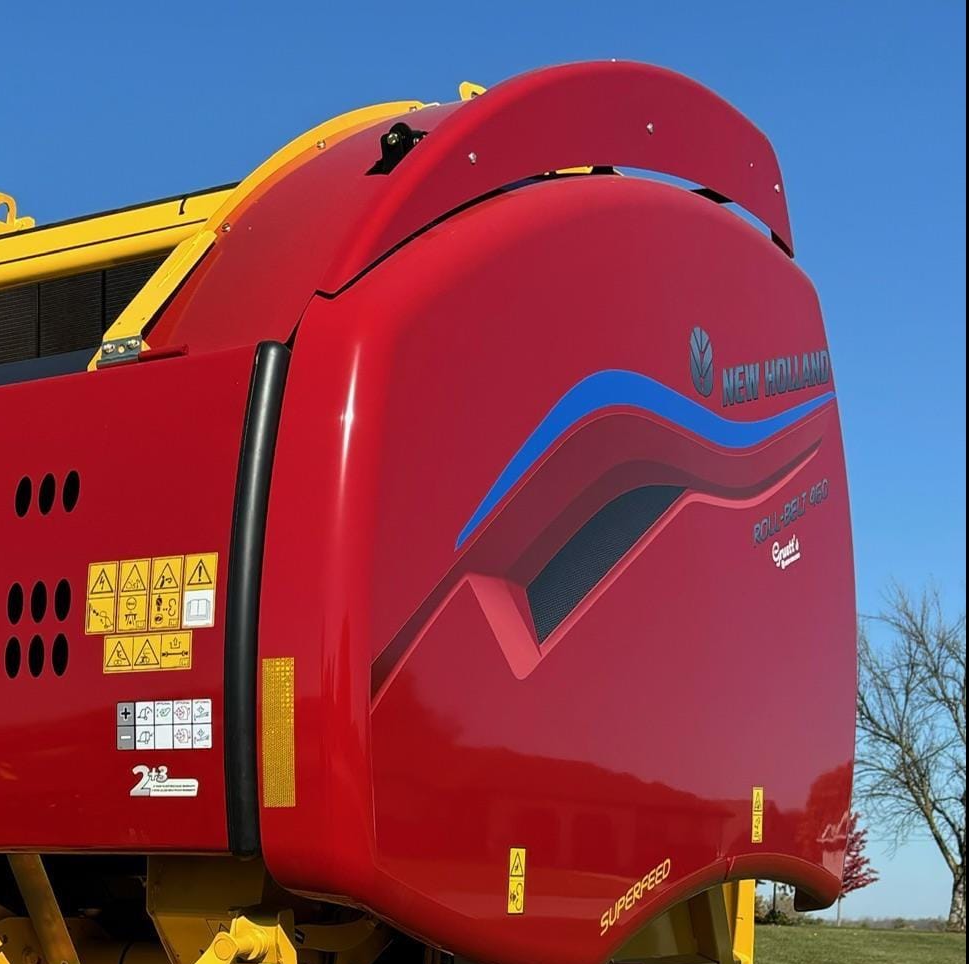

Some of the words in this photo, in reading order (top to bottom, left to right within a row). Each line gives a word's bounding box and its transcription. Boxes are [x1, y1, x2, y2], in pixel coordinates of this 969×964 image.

[722, 363, 760, 408] NEW
[764, 350, 831, 397] HOLLAND
[600, 858, 671, 937] SUPERFEED
